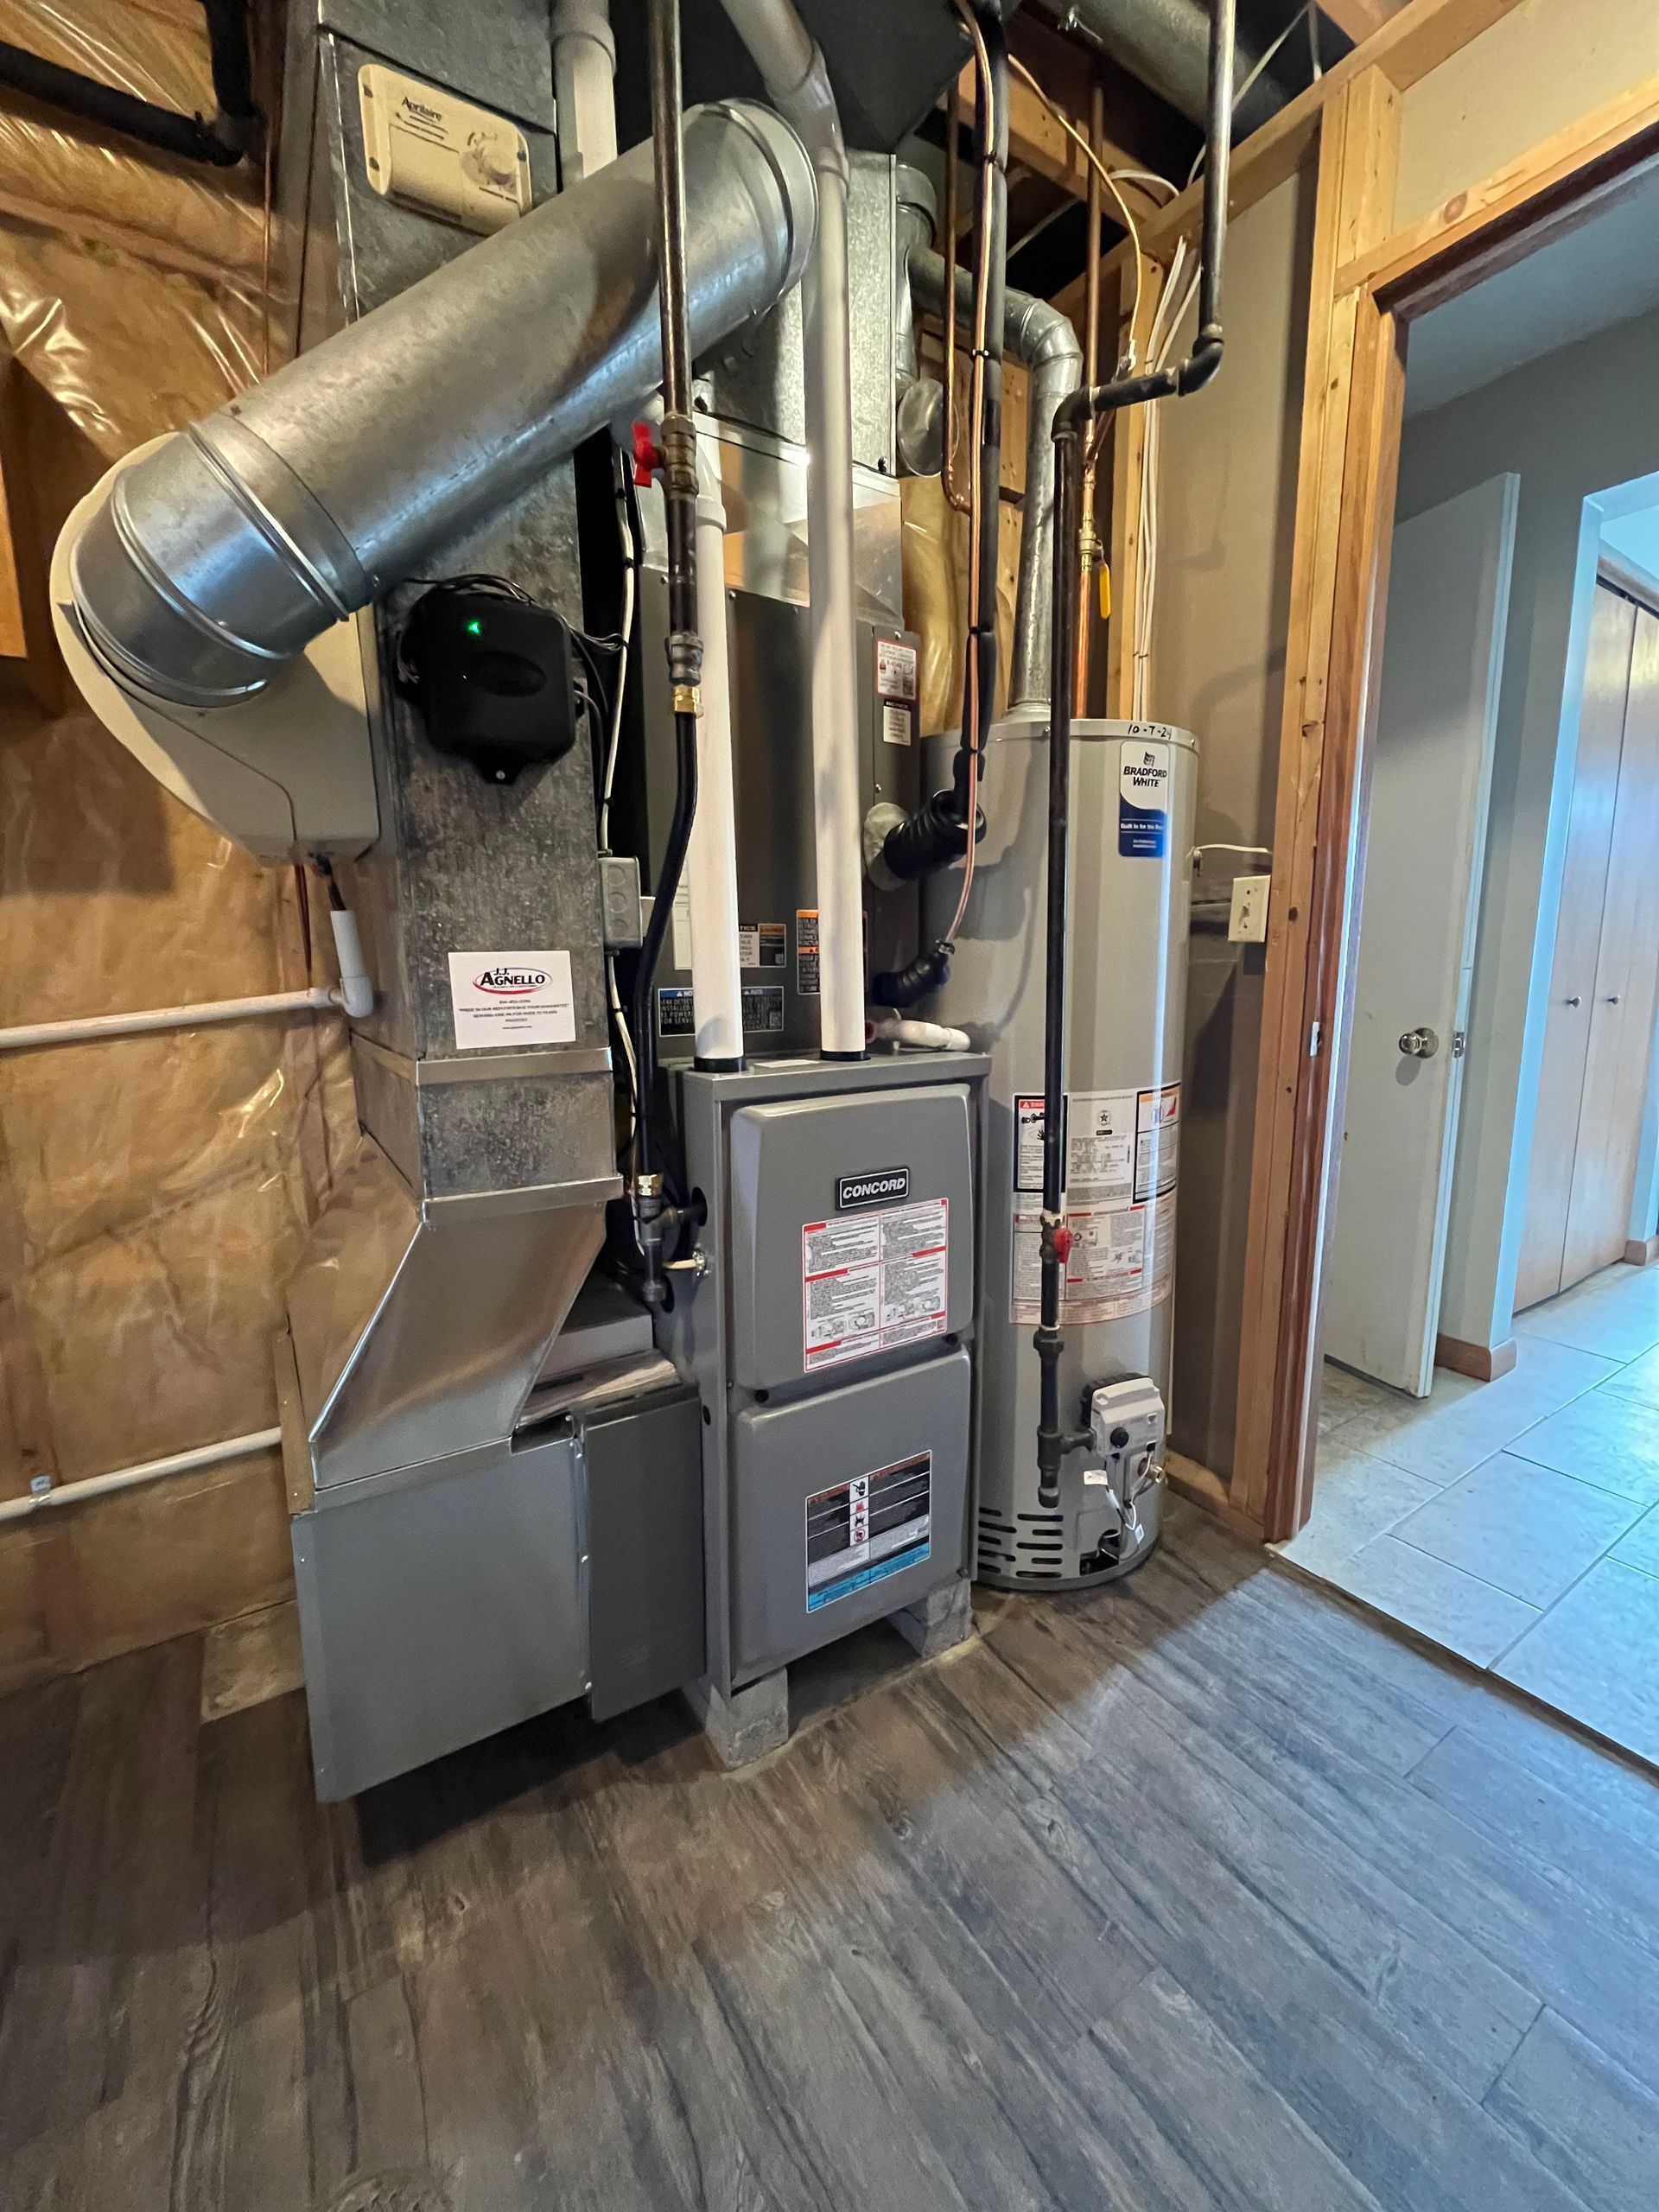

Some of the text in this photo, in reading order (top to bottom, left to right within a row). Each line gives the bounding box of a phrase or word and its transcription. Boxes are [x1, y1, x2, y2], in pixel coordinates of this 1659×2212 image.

[1123, 766, 1167, 779] BRADFORD
[1133, 777, 1160, 787] WHITE
[480, 971, 545, 986] AGNELLO
[842, 1178, 906, 1199] CONCORD
